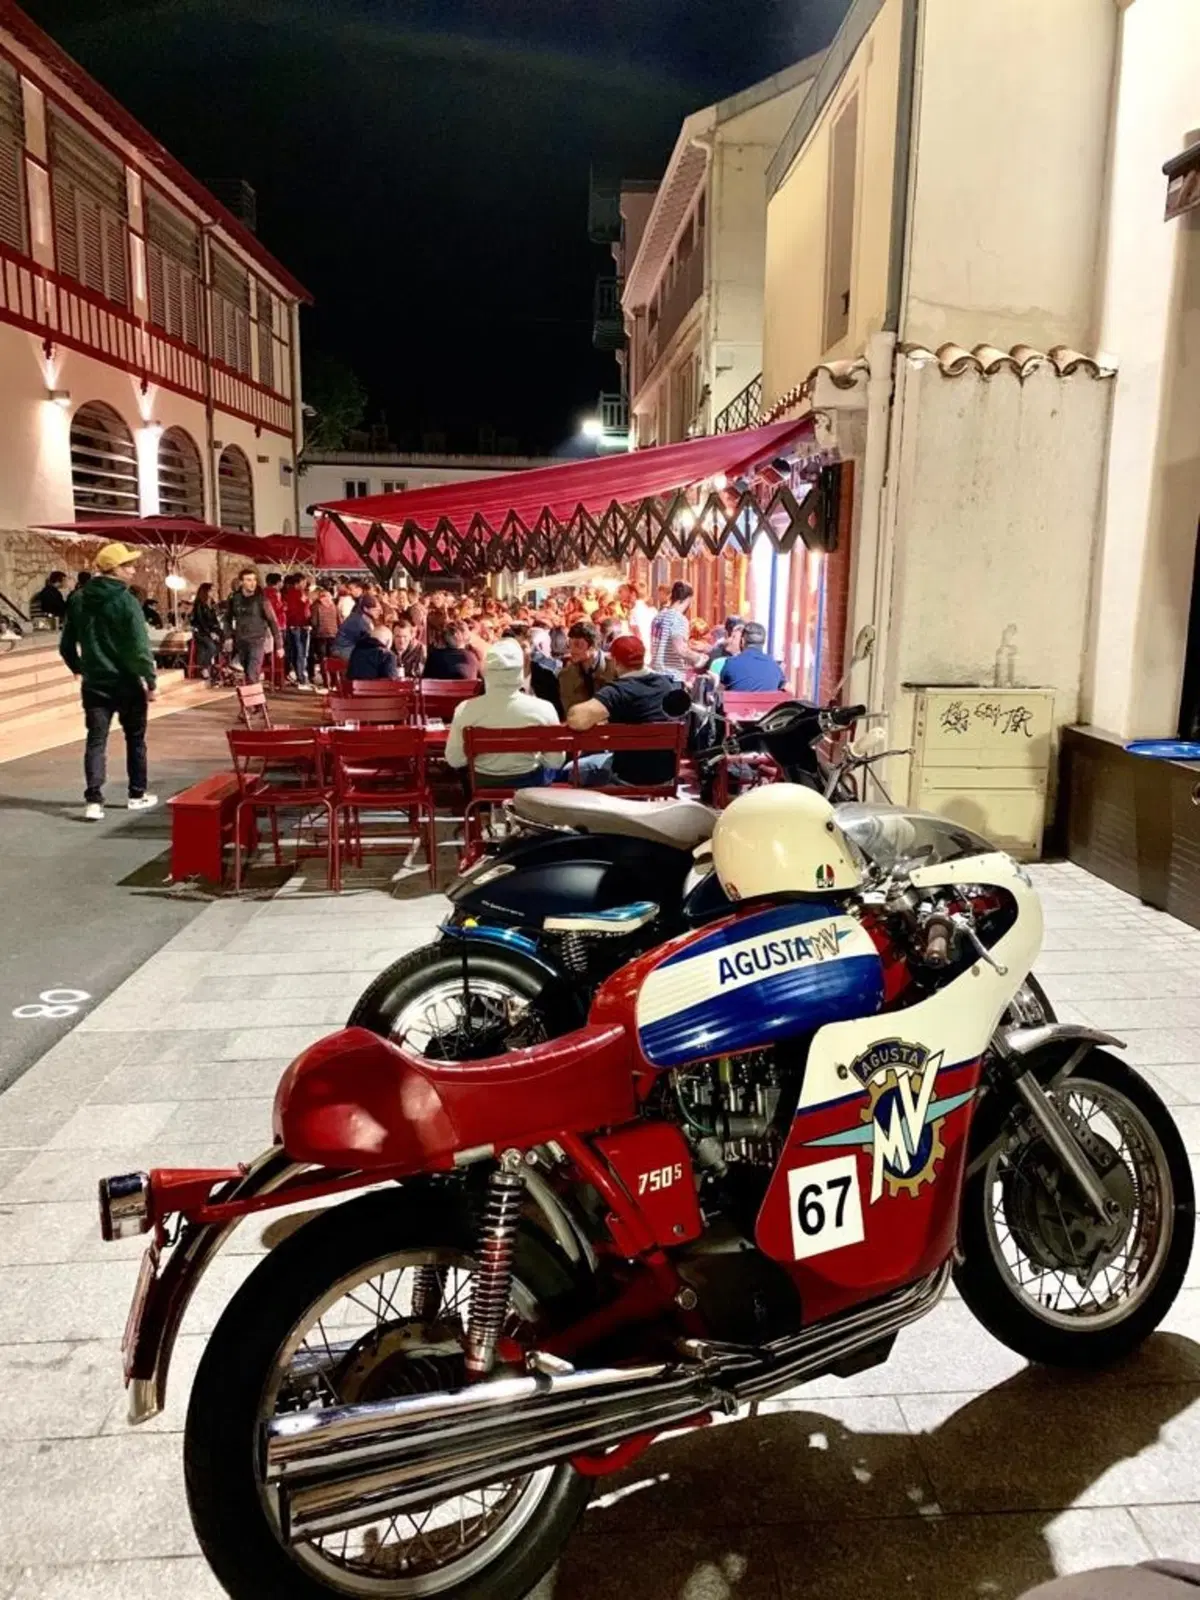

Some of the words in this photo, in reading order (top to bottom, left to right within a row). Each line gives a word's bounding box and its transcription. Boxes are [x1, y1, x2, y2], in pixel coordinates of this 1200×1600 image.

[718, 936, 813, 985] AGUSTA
[861, 1047, 919, 1077] AGUSTA
[869, 1049, 945, 1206] MV
[797, 1174, 852, 1236] 67
